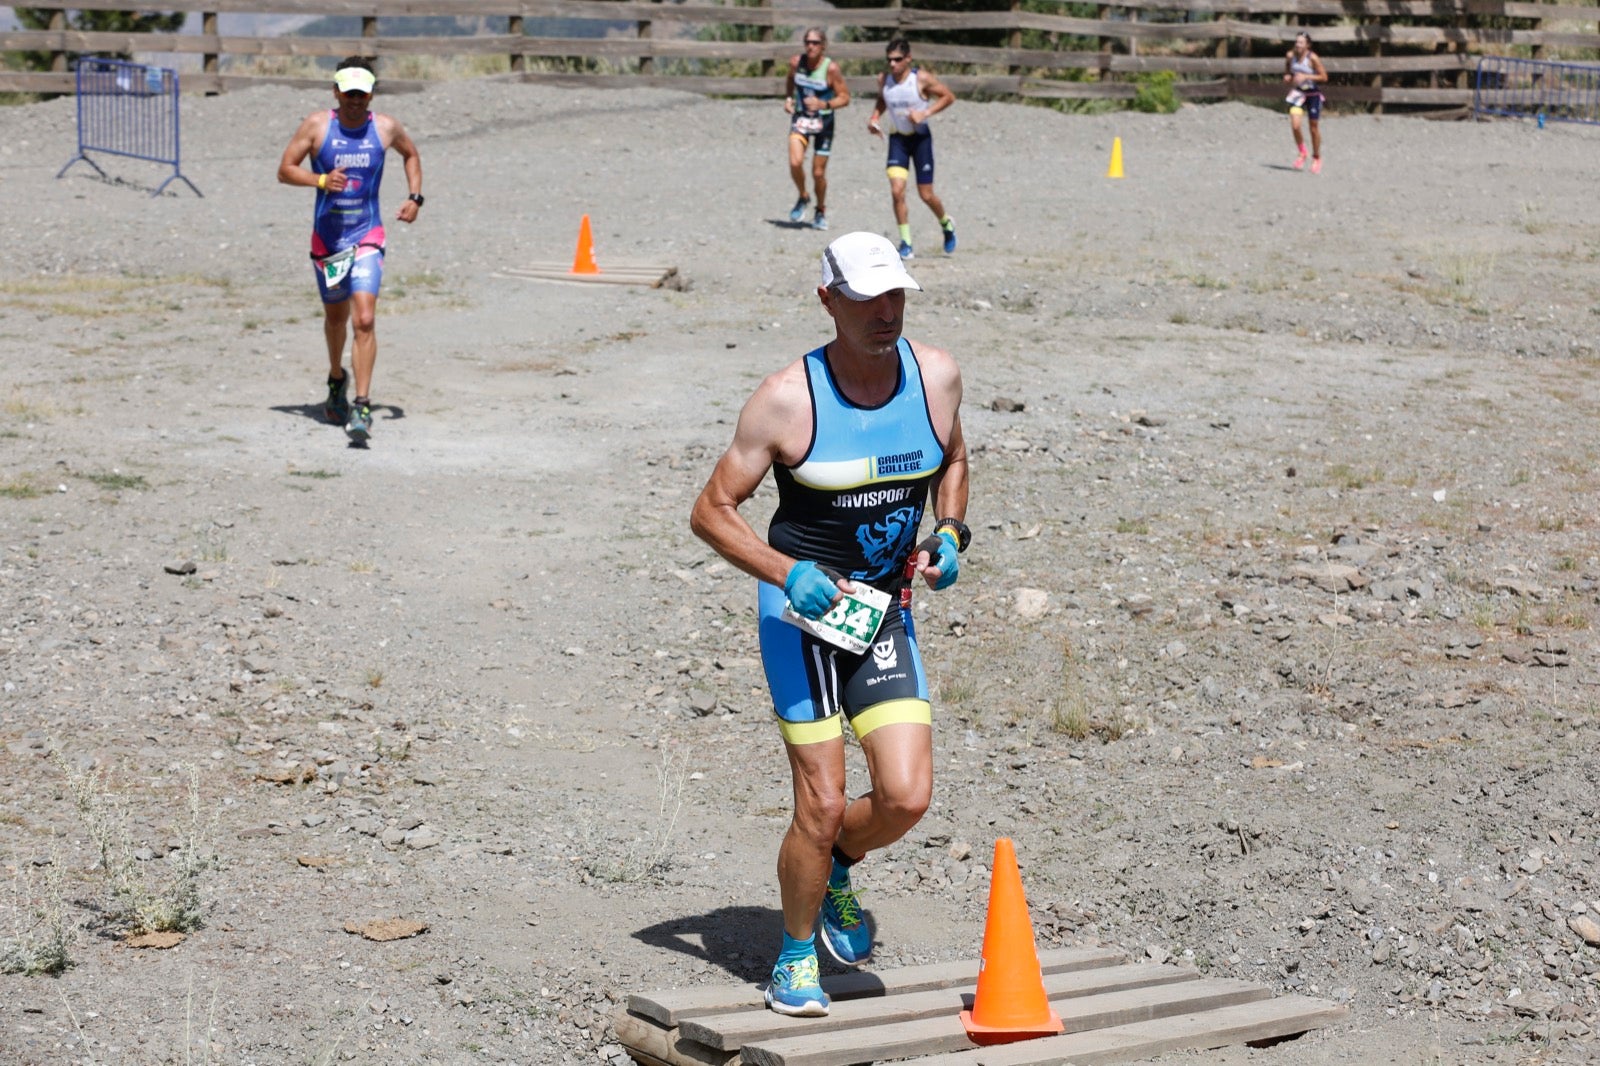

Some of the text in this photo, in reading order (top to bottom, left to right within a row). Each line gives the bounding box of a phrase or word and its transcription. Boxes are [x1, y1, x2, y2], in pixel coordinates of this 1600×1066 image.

[334, 153, 370, 168] CARRASCO
[877, 449, 924, 466] GRANADA
[878, 460, 922, 474] COLLEGE
[832, 486, 914, 508] JAVISPORT
